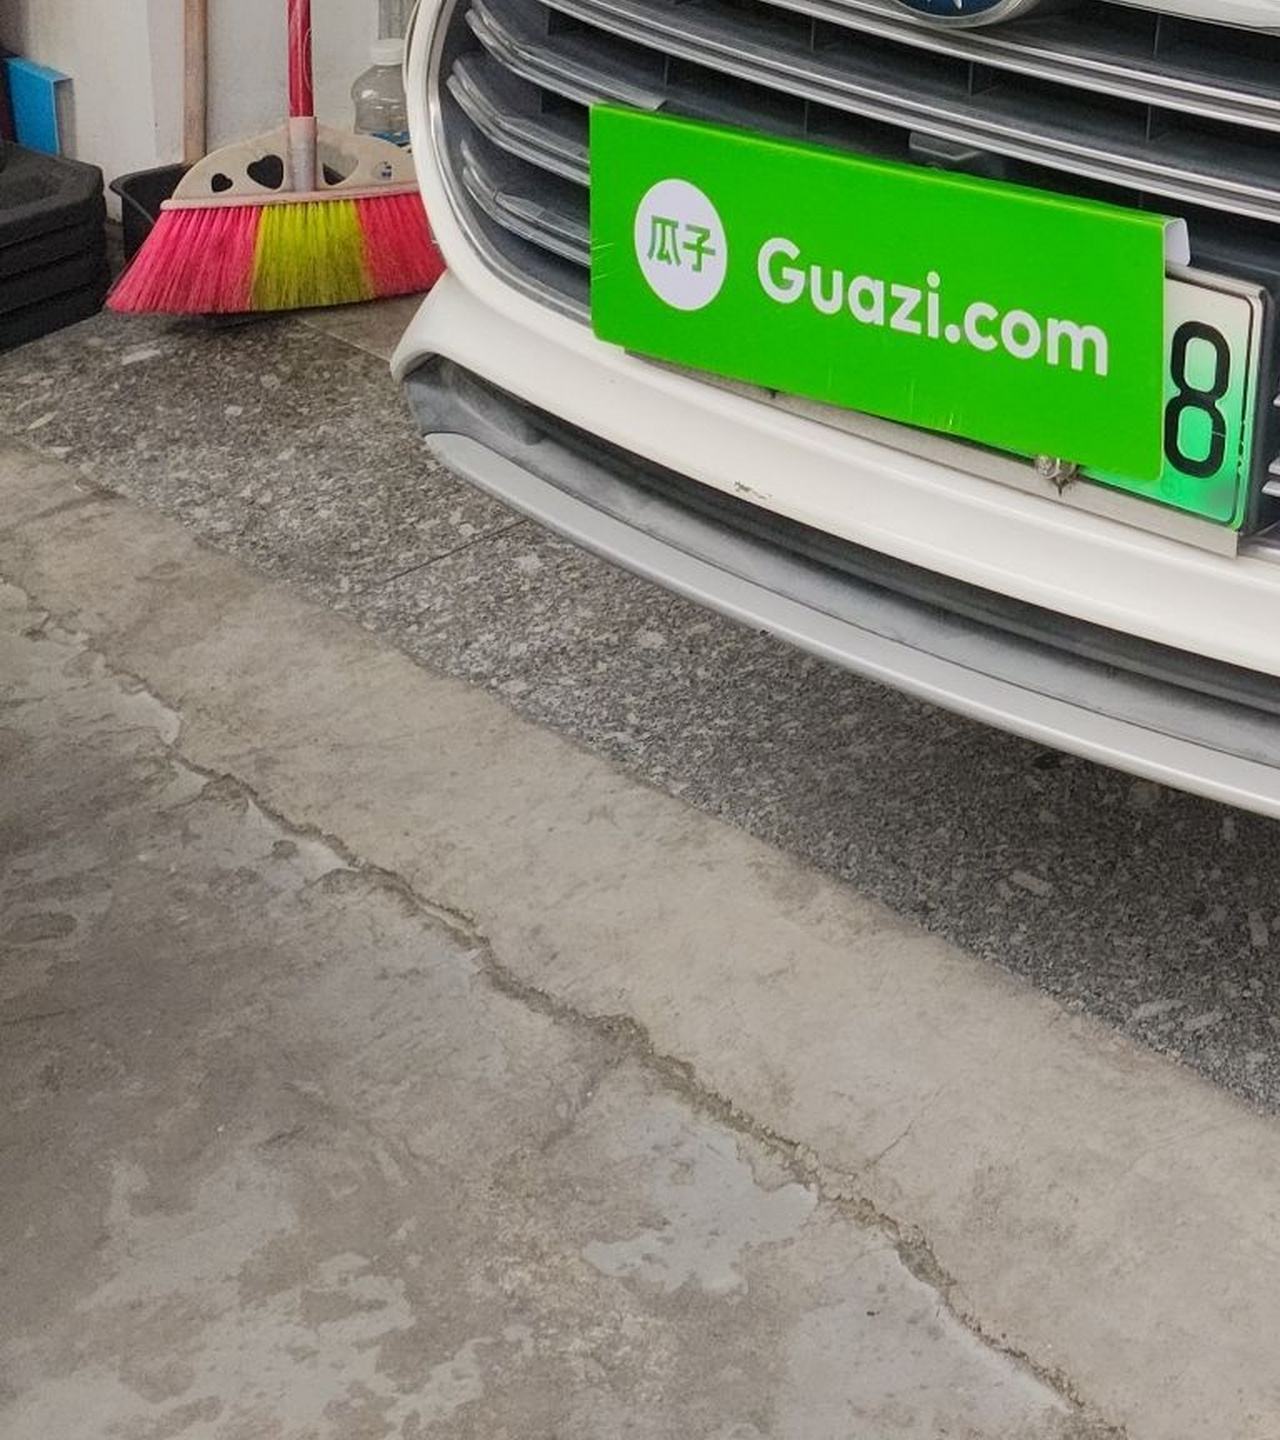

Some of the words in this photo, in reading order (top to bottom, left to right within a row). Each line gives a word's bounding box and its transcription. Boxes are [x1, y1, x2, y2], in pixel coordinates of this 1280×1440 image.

[647, 214, 716, 272] 瓜子
[757, 237, 1109, 376] Guazi.com
[1163, 320, 1231, 479] 8
